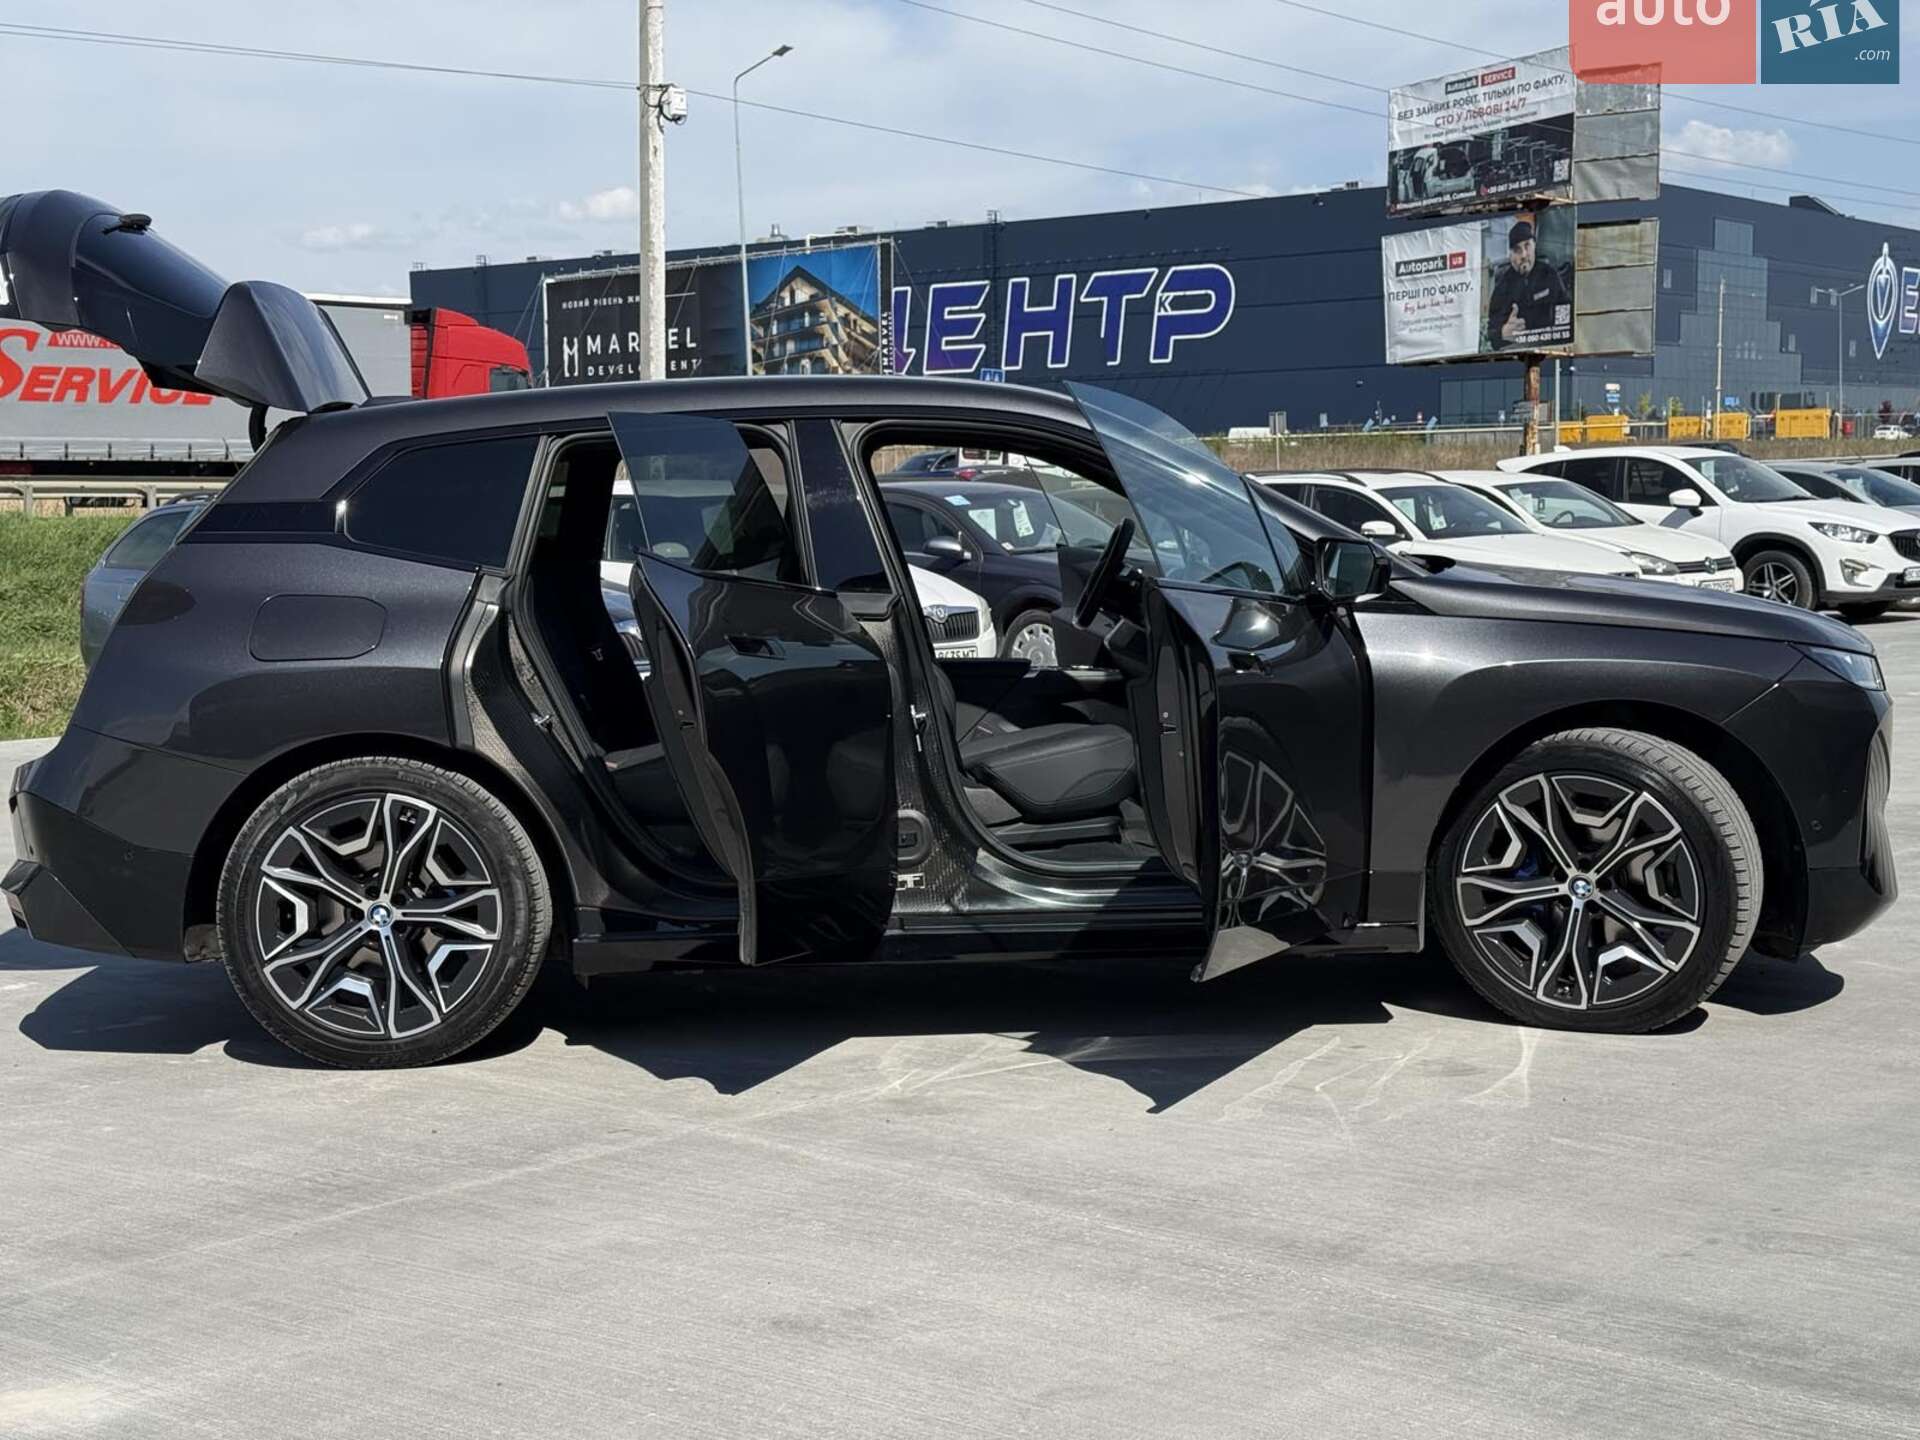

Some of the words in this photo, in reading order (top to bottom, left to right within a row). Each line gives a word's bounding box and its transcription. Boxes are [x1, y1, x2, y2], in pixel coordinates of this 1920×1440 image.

[1483, 69, 1514, 85] SERVICE
[1397, 109, 1414, 121] БЕЗ
[1483, 86, 1515, 101] ТІЛЬКИ
[1517, 82, 1532, 94] ПО
[1534, 74, 1567, 90] ФАКТУ.
[1435, 114, 1454, 127] СТО
[1455, 111, 1463, 123] У
[1504, 97, 1526, 113] 24/7
[1398, 257, 1444, 275] Autopark
[1388, 290, 1420, 302] ПЕРШІ
[1423, 286, 1437, 297] ПО
[1439, 281, 1473, 294] ФАКТУ.
[587, 326, 697, 355] MAREL
[587, 358, 699, 376] DEVELENT
